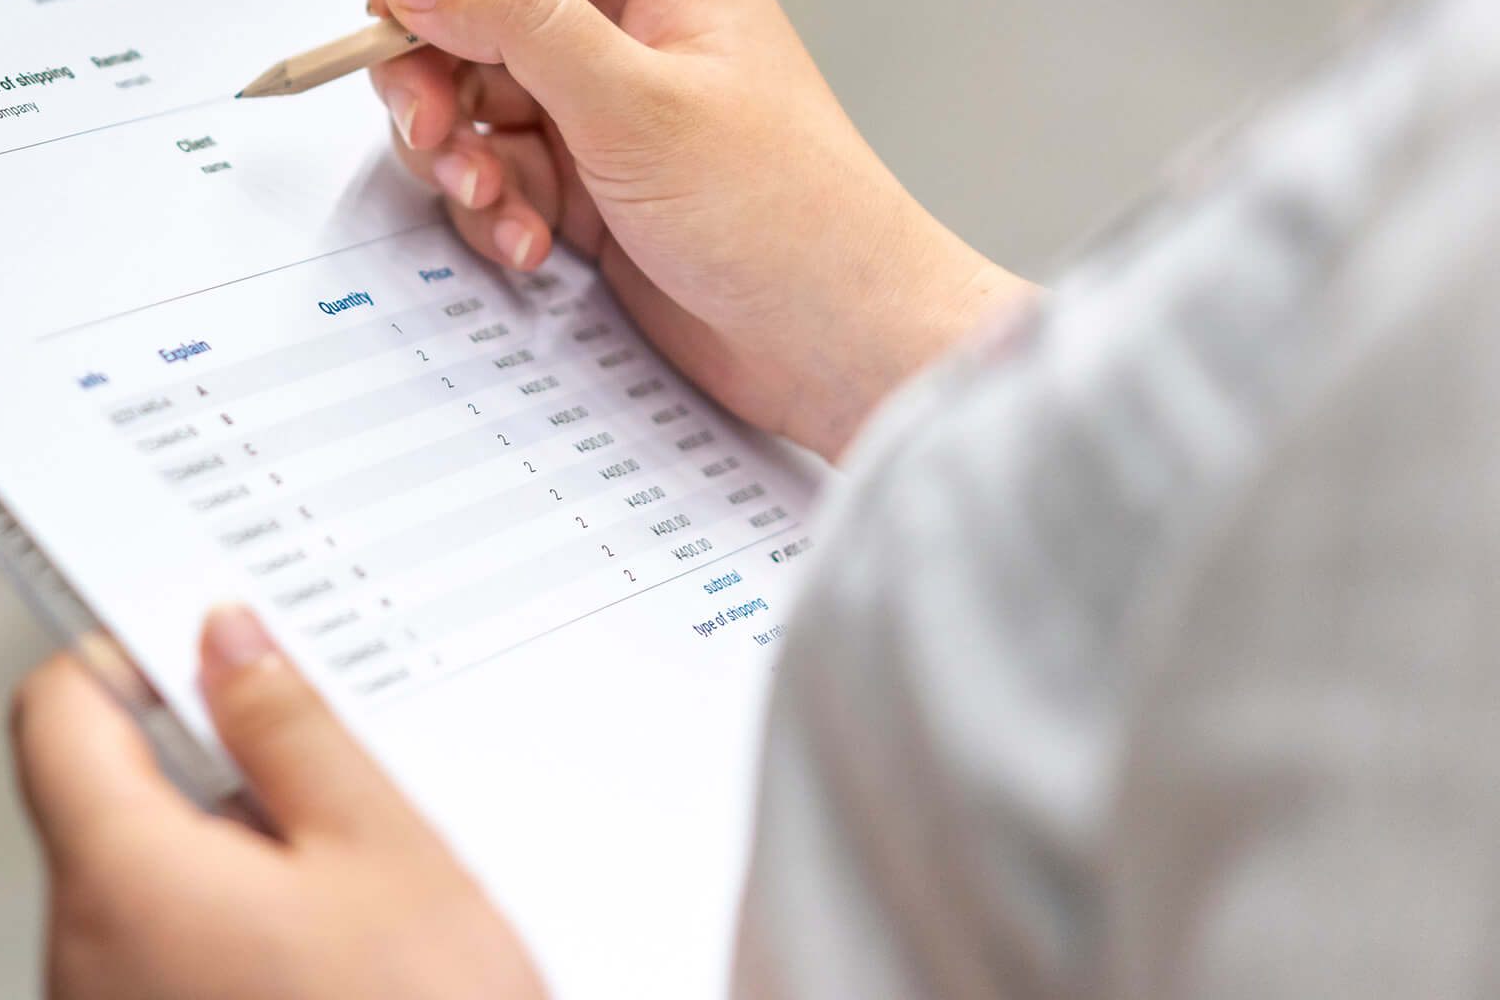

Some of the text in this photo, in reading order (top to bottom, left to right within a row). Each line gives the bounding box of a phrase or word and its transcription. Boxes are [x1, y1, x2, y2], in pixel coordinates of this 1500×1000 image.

[0, 75, 16, 91] of
[15, 65, 76, 88] shipping
[318, 291, 375, 315] Quantity
[391, 323, 403, 334] 1
[158, 340, 213, 363] Explain
[416, 349, 429, 361] 2
[441, 376, 455, 388] 2
[467, 403, 481, 415] 2
[497, 434, 510, 445] 2
[523, 461, 537, 473] 2
[549, 488, 562, 500] 2
[575, 485, 666, 528] 2 ¥400.00
[601, 513, 691, 557] 2 ¥400.00
[623, 537, 713, 582] 2 ¥400.00
[703, 569, 744, 595] subtotal
[692, 596, 770, 638] type of shipping
[752, 633, 771, 647] tax
